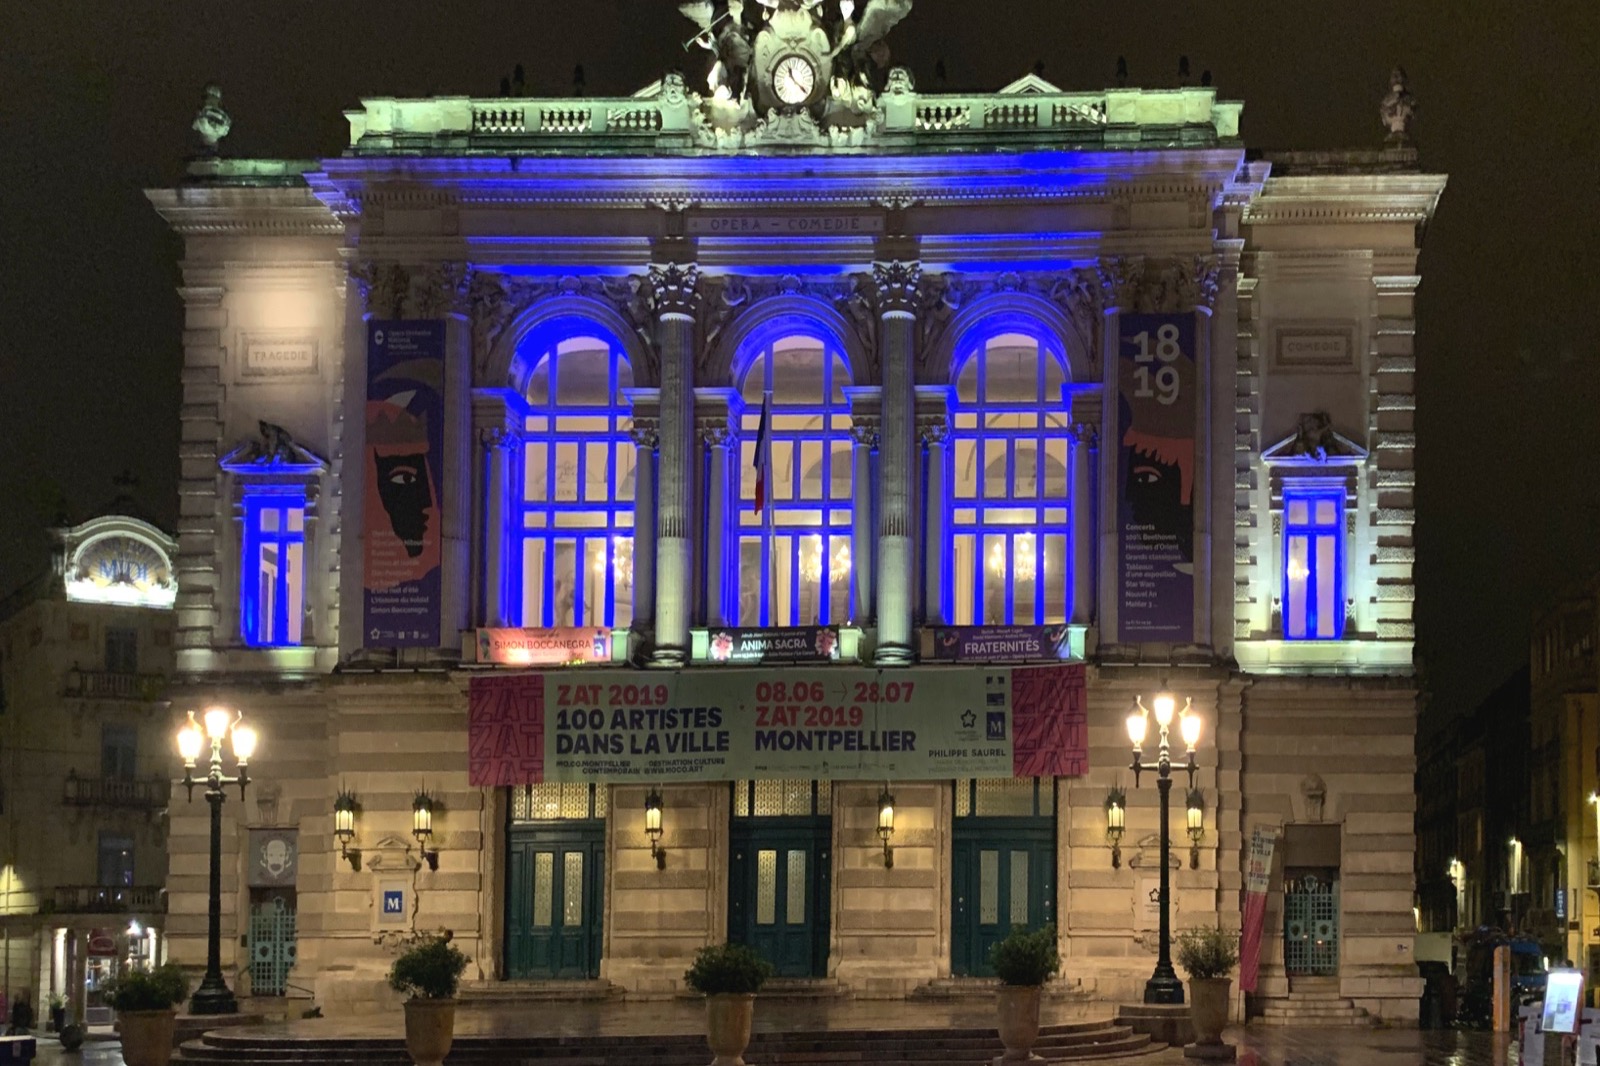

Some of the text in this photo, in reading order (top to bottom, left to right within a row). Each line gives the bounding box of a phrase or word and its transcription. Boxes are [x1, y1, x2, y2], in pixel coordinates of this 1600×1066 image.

[711, 219, 761, 230] OPERA
[787, 218, 860, 230] COMEDIE
[1133, 323, 1180, 362] 18
[253, 351, 308, 362] TRAGEDIE
[1133, 366, 1180, 405] 19
[1125, 523, 1155, 531] Concerts
[494, 638, 592, 650] SIMON BOCCANEGRA
[740, 638, 808, 651] ANIMA SACRA
[964, 638, 1040, 655] FRATERNITÉS
[556, 684, 668, 706] ZAT 2019
[755, 681, 915, 703] 08.06 28.07
[556, 707, 722, 730] 100 ARTISTES
[755, 705, 864, 726] ZAT 2019
[556, 731, 730, 755] DANS LA VILLE
[755, 730, 917, 752] MONTPELLIER
[693, 757, 726, 765] CULTURE
[928, 748, 1006, 758] PHILIPPE SAUREL
[388, 897, 399, 910] M
